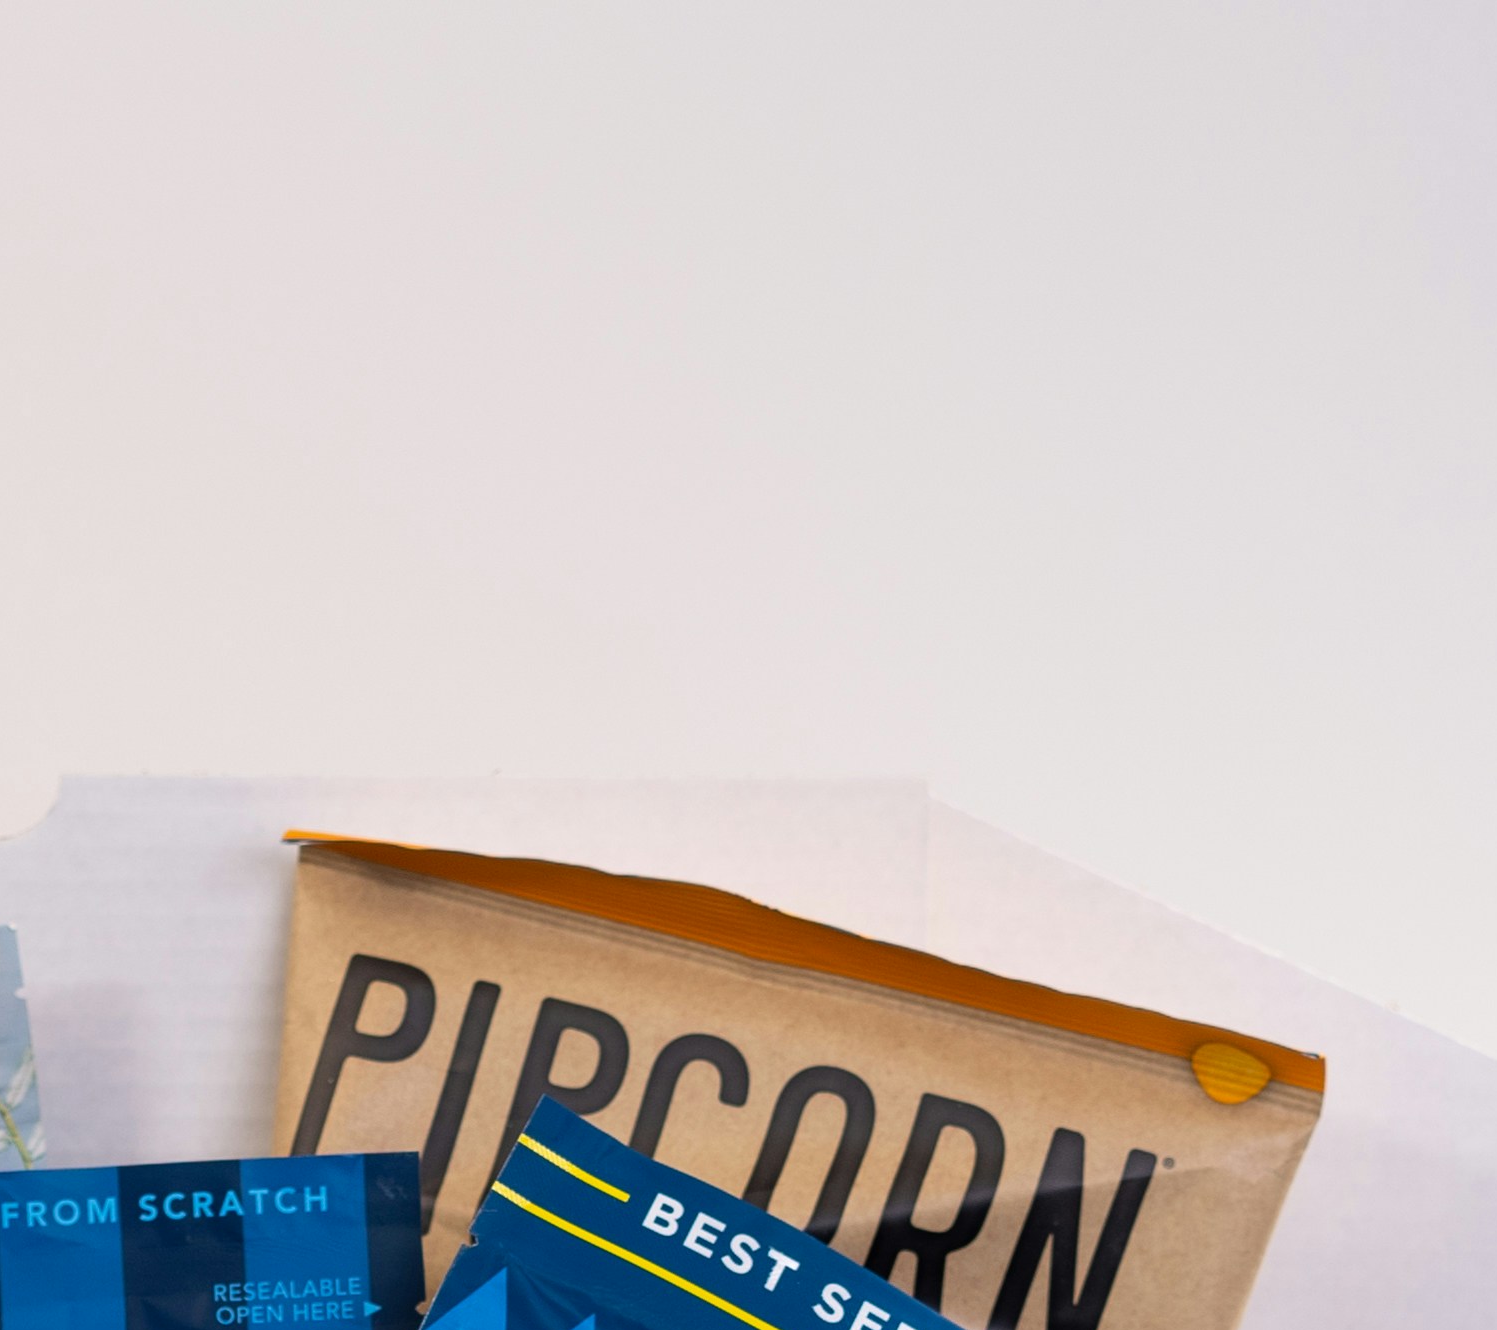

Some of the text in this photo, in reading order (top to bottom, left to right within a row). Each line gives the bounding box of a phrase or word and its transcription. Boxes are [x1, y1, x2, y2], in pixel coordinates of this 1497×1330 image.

[1, 1197, 118, 1229] FROM
[139, 1186, 329, 1222] SCRATCH
[642, 1193, 799, 1293] BEST
[213, 1277, 362, 1303] RESEALABLE
[215, 1300, 355, 1326] OPEN HERE
